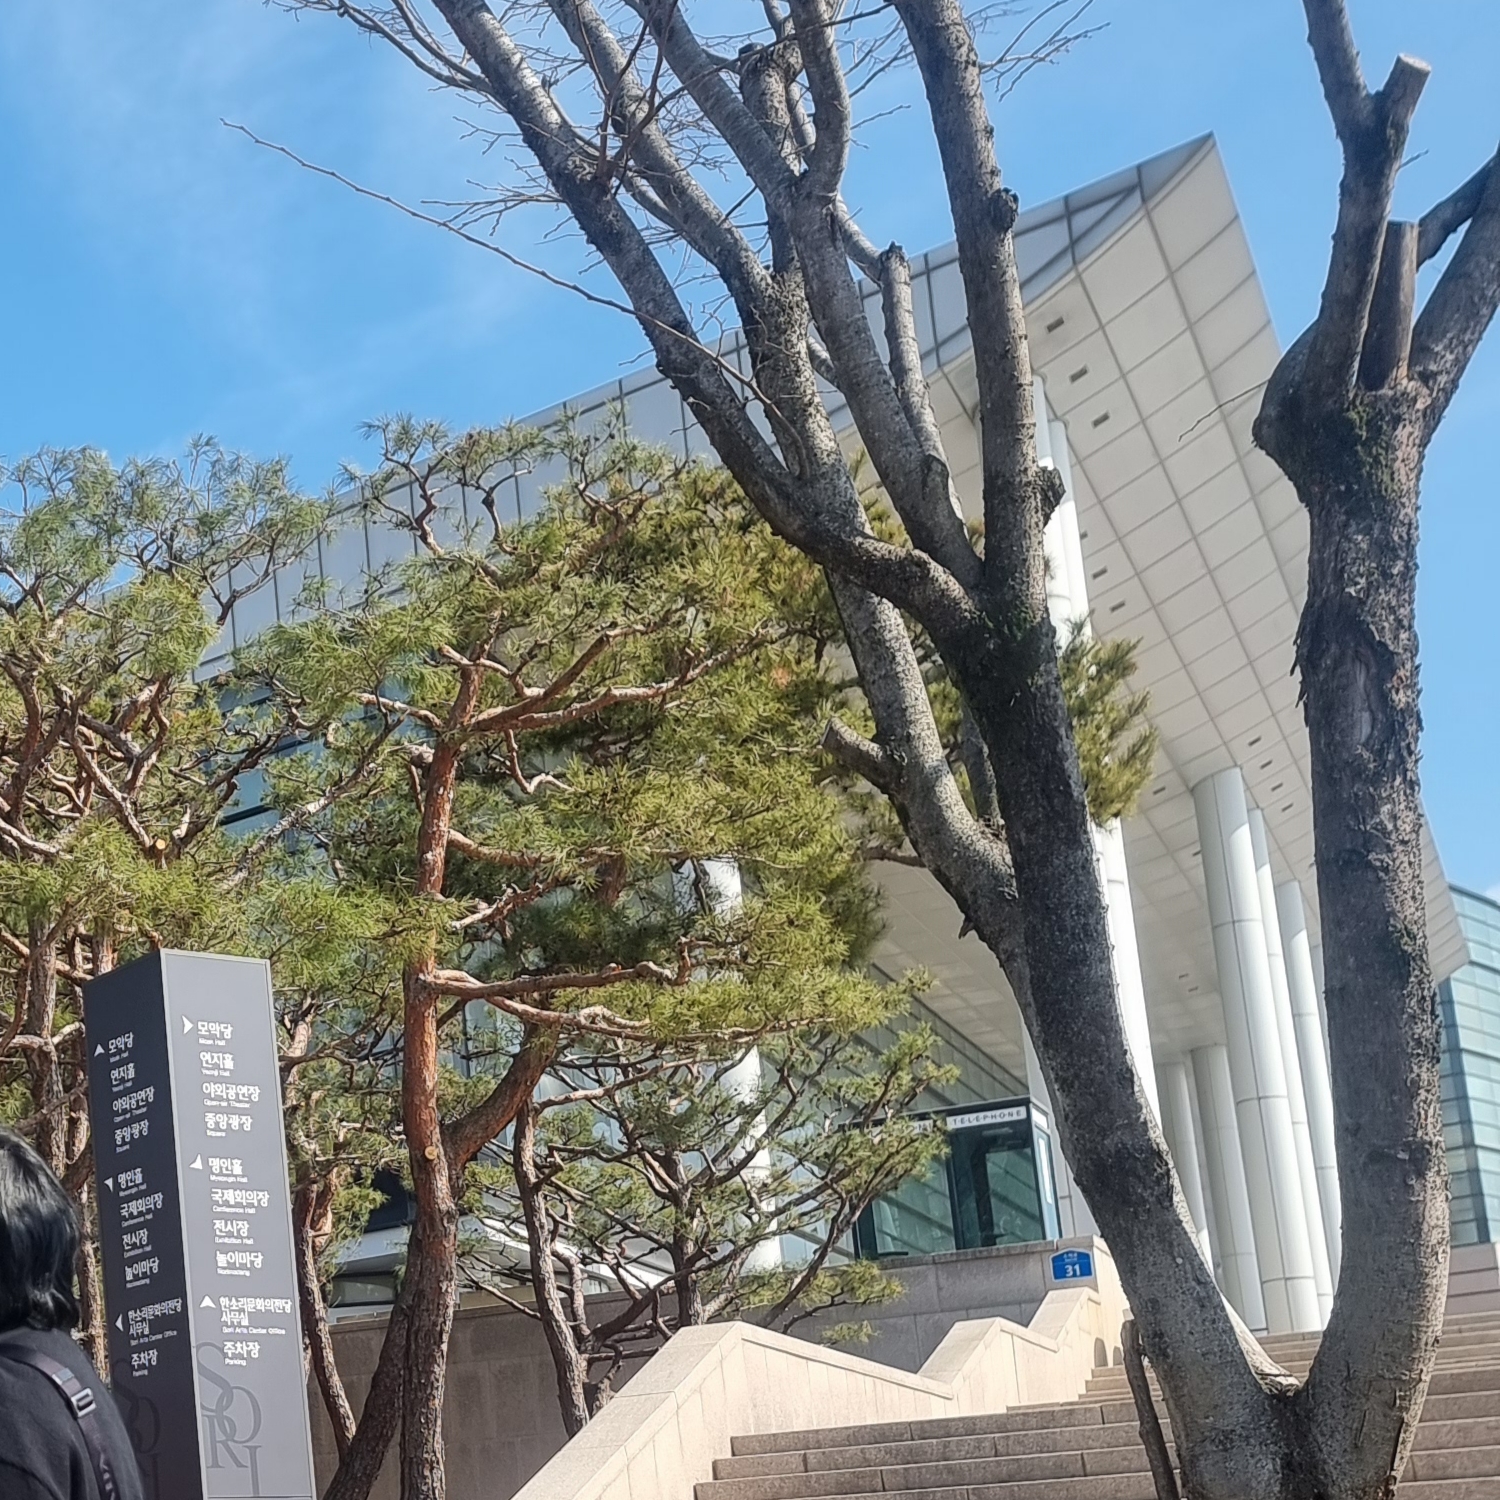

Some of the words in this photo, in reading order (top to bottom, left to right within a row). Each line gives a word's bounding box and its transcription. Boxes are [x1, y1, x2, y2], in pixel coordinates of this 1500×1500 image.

[197, 1021, 233, 1039] 모악당
[108, 1031, 134, 1053] 모악당
[200, 1052, 234, 1070] 연지홀
[110, 1062, 135, 1085] 연지홀
[112, 1085, 155, 1113] 야외공연장
[203, 1082, 261, 1101] 야외공연장
[205, 1113, 252, 1131] 중앙광장
[953, 1110, 1022, 1125] TELEPHONE
[114, 1119, 149, 1145] 중앙광장
[208, 1157, 243, 1175] 명인홀
[118, 1168, 142, 1188] 명인홀
[120, 1192, 163, 1218] 국제회의장
[211, 1188, 270, 1207] 국제회의장
[213, 1220, 249, 1236] 전시장
[122, 1228, 148, 1250] 전시장
[216, 1250, 264, 1268] 놀이마당
[125, 1256, 159, 1281] 놀이마당
[1065, 1264, 1080, 1276] 31
[220, 1296, 292, 1313] 한소리문화의전당
[221, 1310, 249, 1326] 사무실
[129, 1320, 149, 1337] 사무실
[224, 1341, 260, 1358] 주차장
[131, 1349, 158, 1369] 주차장
